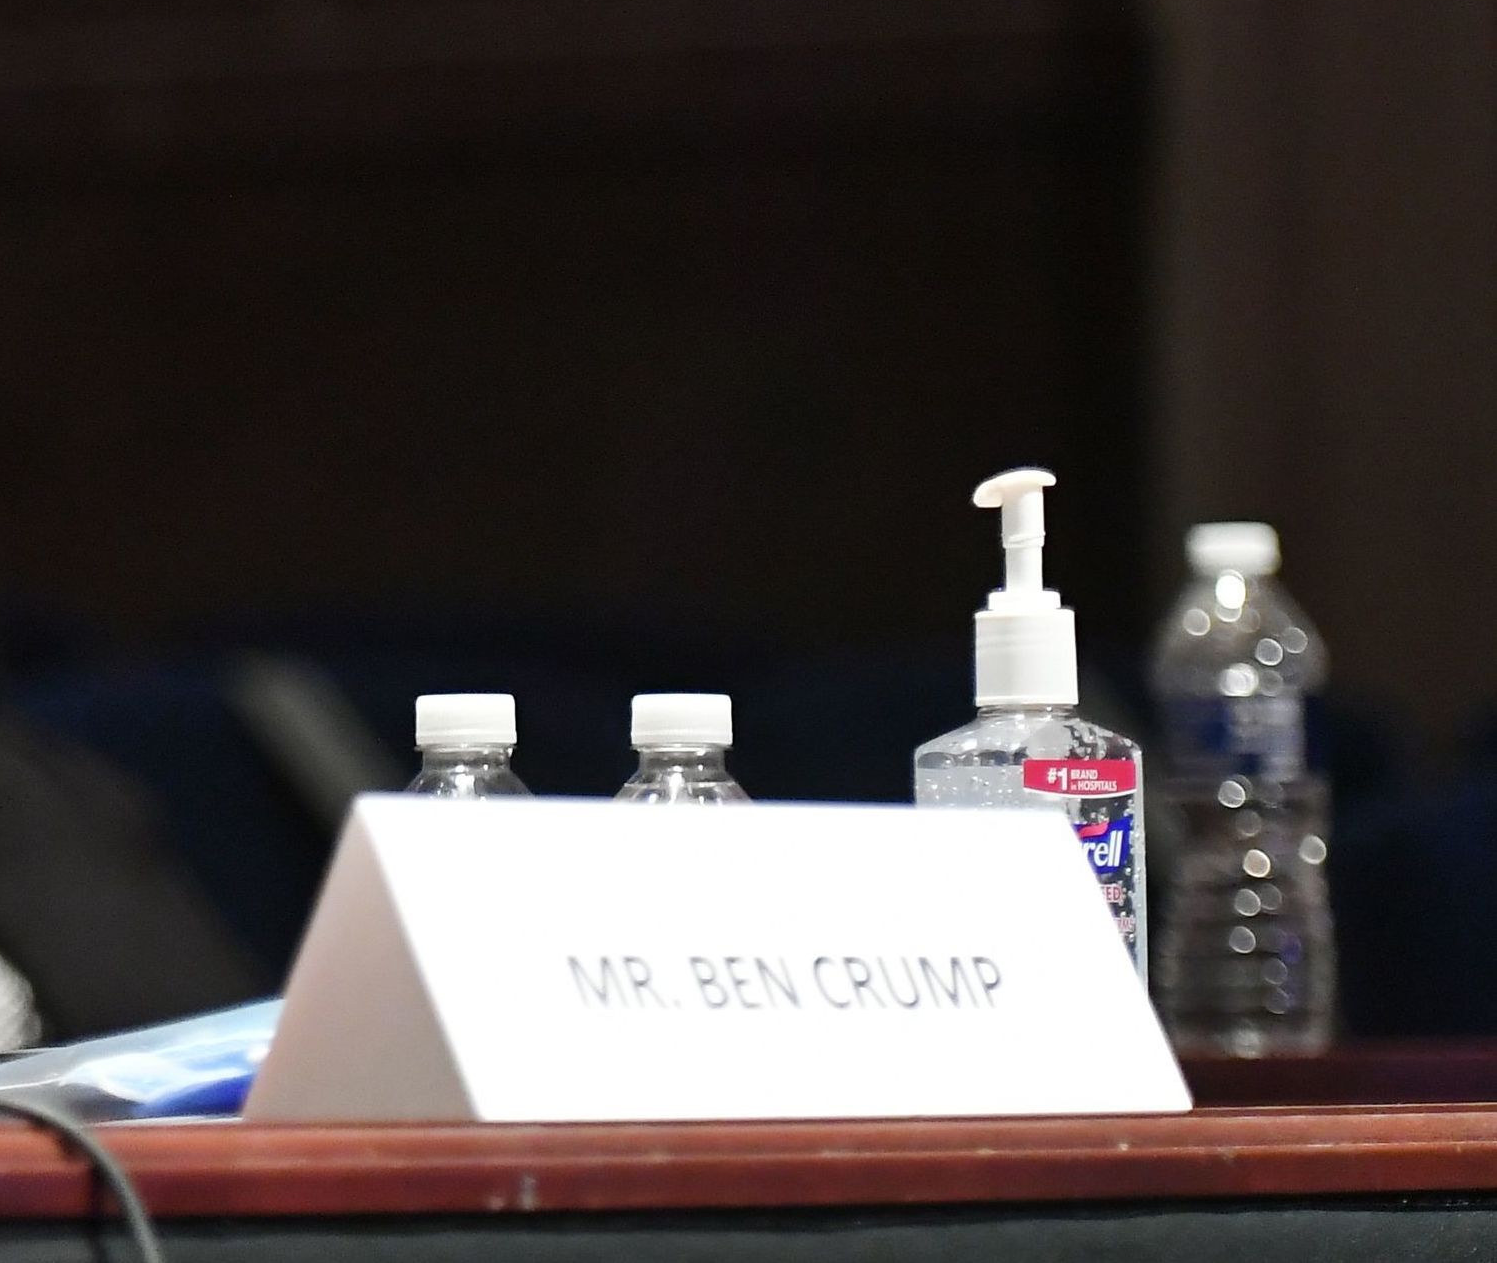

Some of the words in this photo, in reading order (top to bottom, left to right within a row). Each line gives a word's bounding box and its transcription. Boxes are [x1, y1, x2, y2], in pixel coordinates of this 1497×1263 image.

[1047, 767, 1067, 790] #1
[1070, 769, 1098, 780] BRAND
[1078, 781, 1117, 791] HOSPITALS
[566, 955, 681, 1009] MR.
[688, 955, 802, 1009] BEN
[812, 955, 1002, 1010] CRUMP
